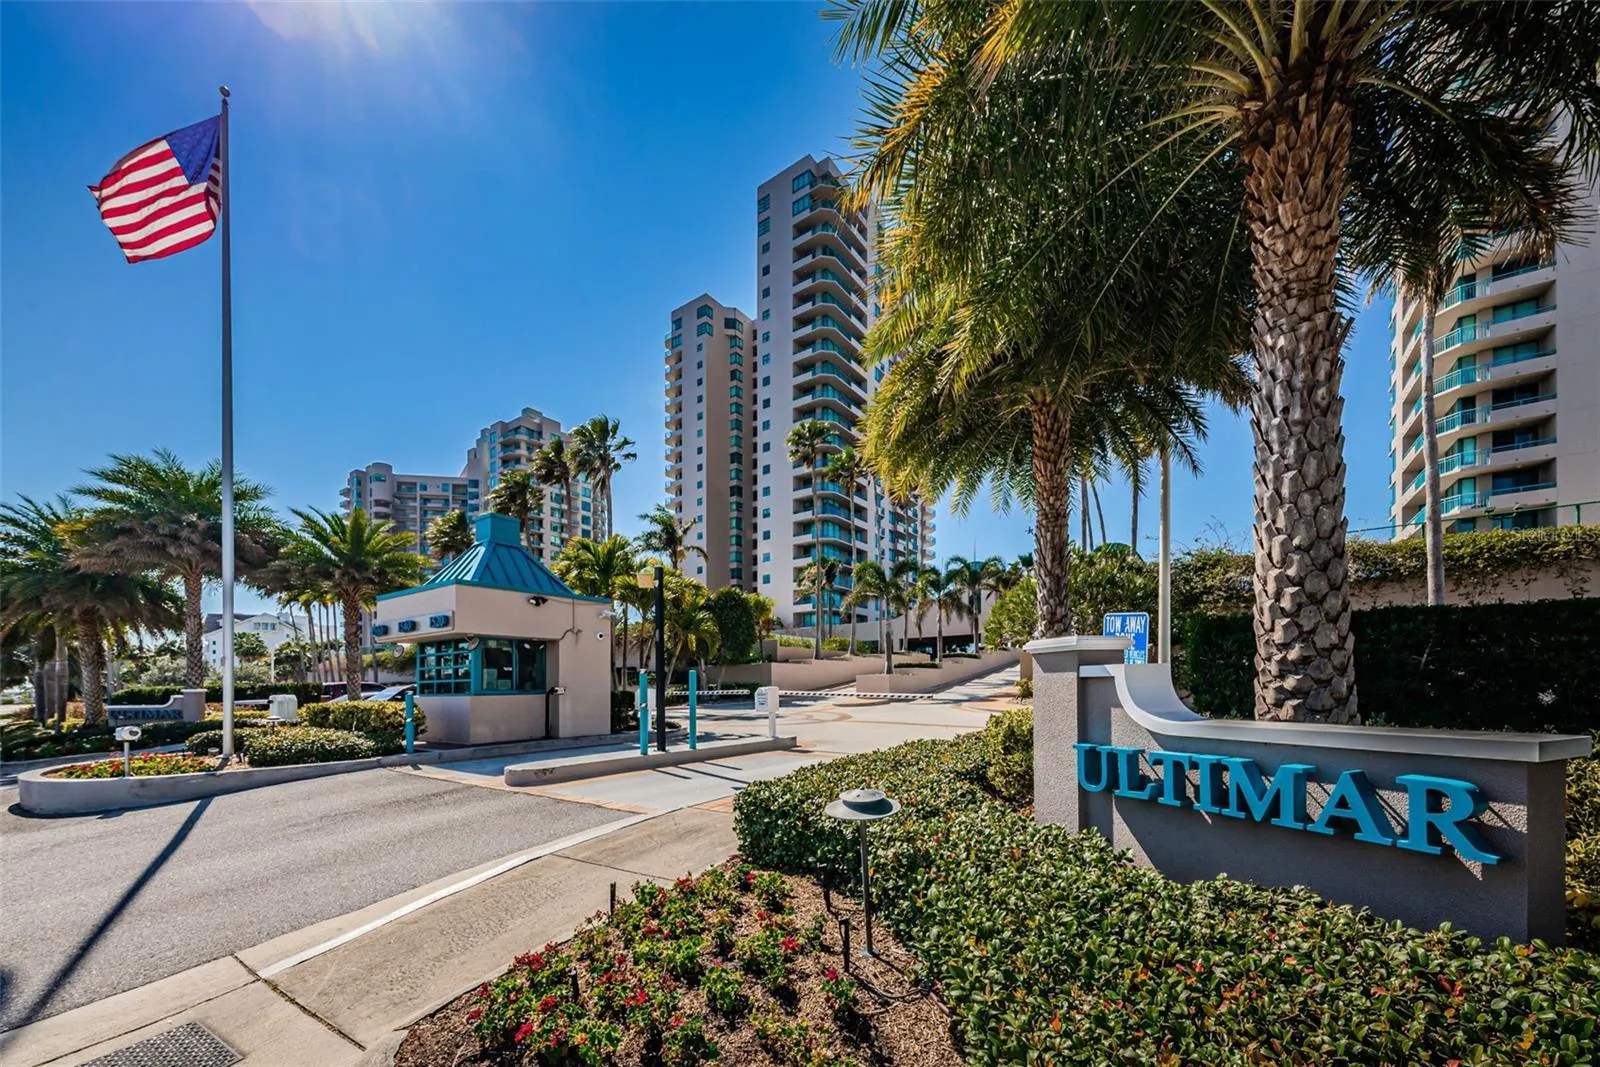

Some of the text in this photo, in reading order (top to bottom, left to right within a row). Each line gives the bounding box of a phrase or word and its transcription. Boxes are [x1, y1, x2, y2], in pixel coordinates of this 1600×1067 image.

[1105, 615, 1146, 633] TOW AWAY
[1073, 743, 1501, 865] ULTIMAR
